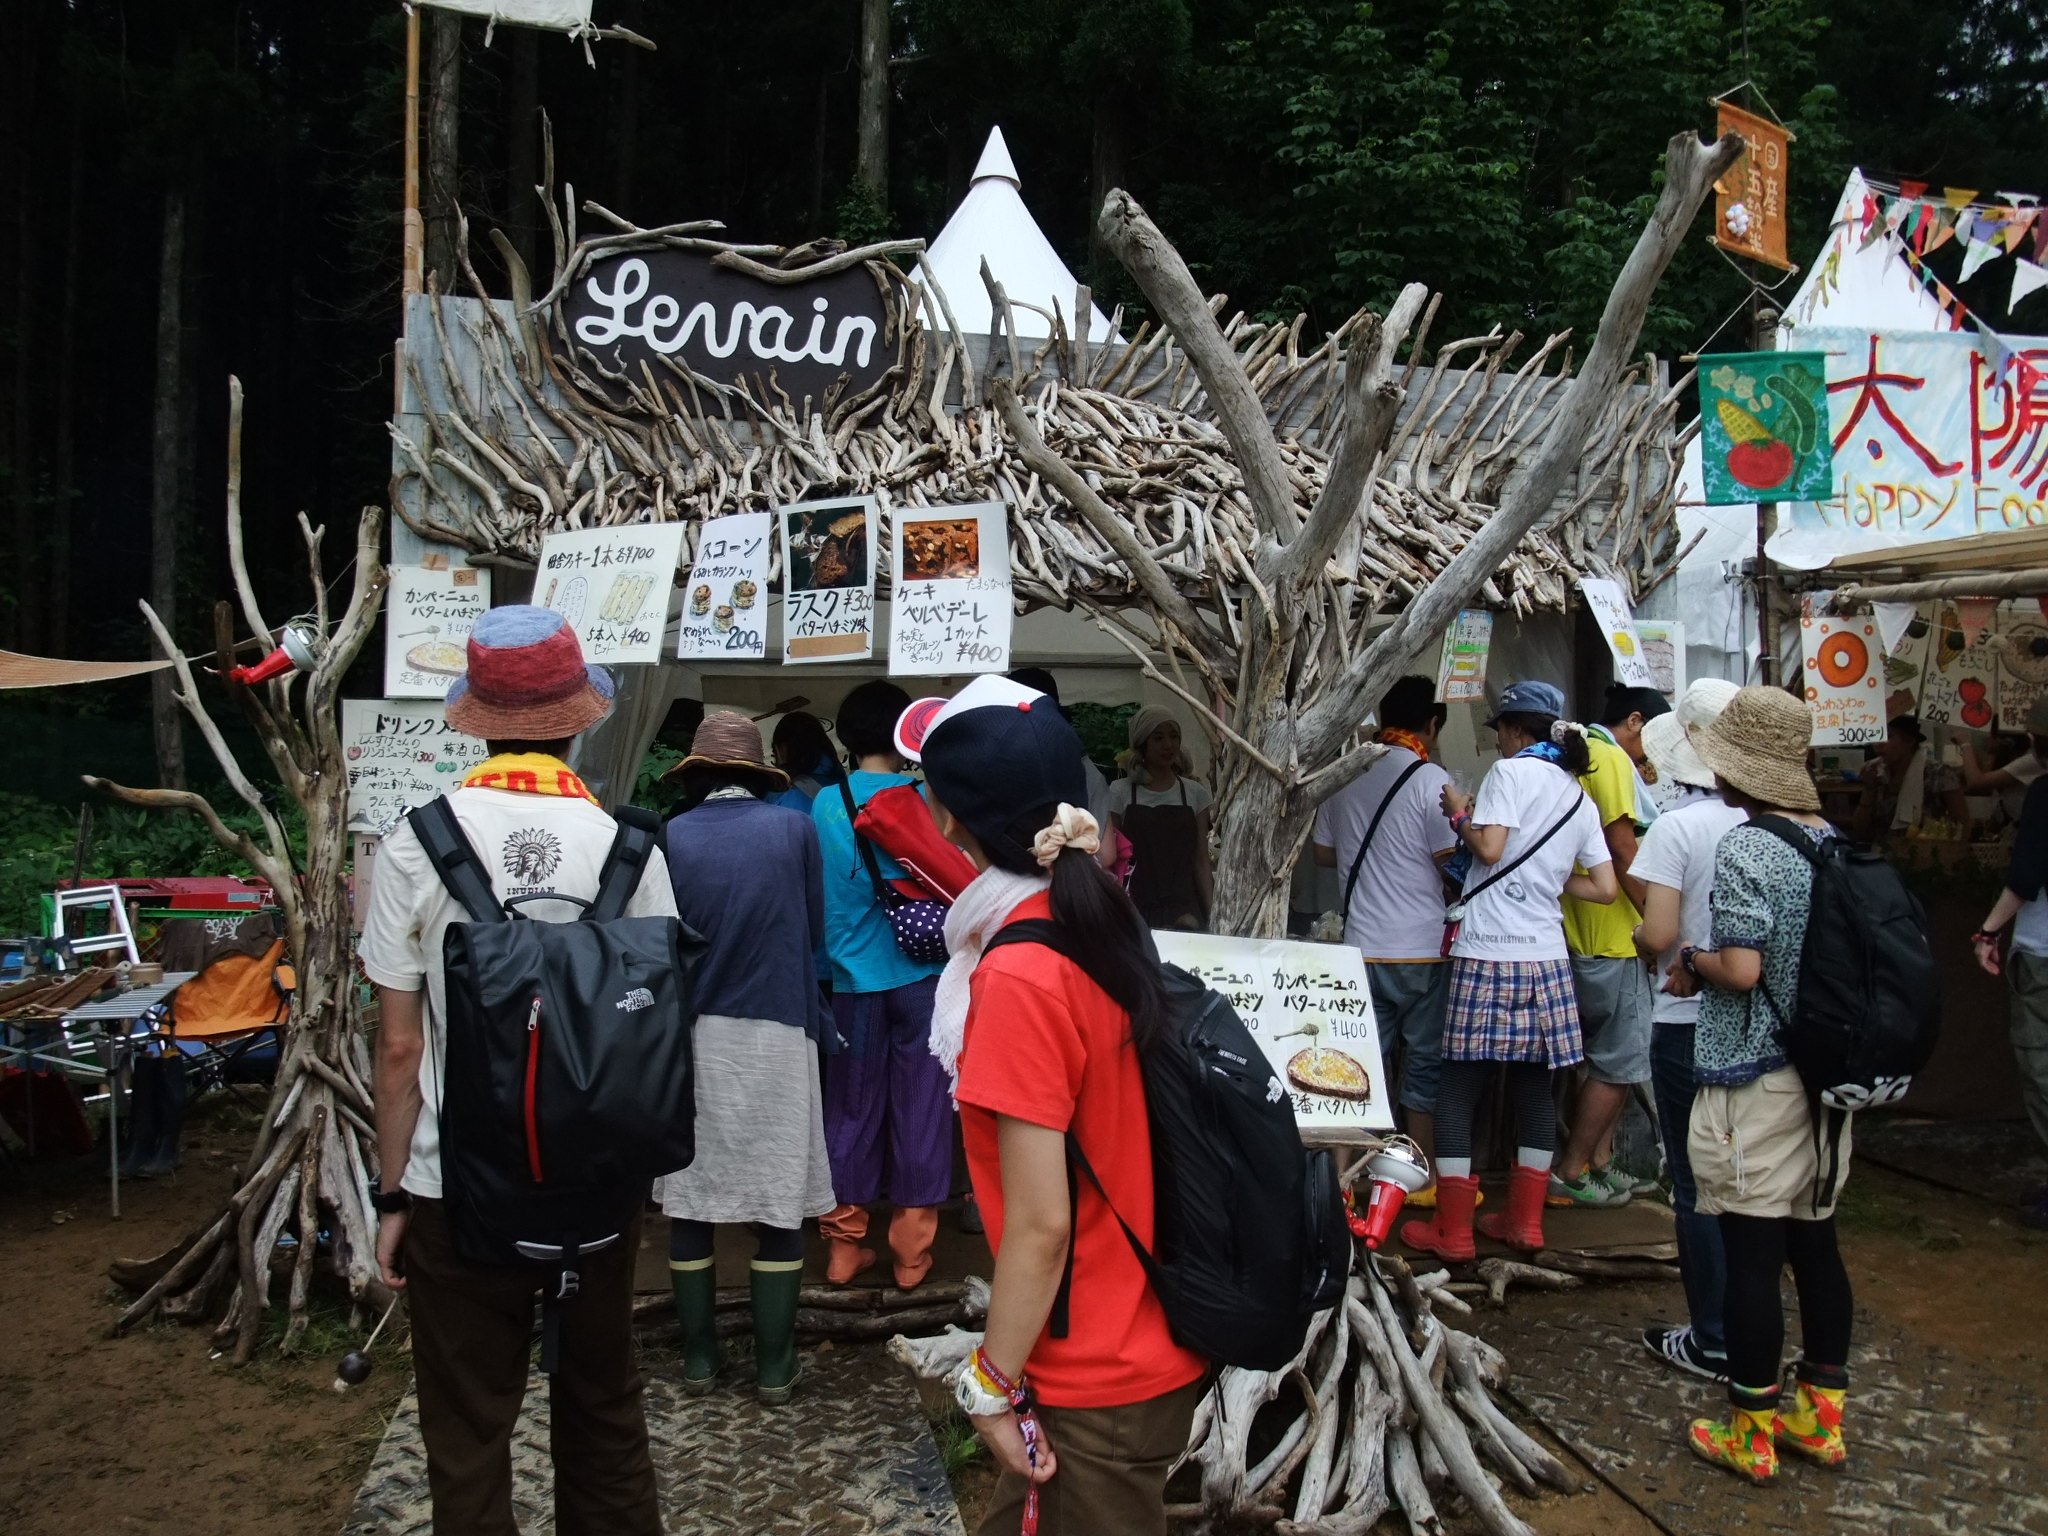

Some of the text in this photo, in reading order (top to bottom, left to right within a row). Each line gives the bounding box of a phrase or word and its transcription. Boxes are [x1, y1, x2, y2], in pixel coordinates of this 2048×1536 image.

[575, 258, 877, 368] Levain
[701, 537, 762, 563] スコーン
[405, 588, 479, 604] カンペーニュの
[898, 582, 936, 602] ケーキ
[788, 588, 873, 621] ラスク ¥300
[902, 600, 988, 624] ベルベデーレ
[447, 622, 472, 635] ¥40
[620, 627, 650, 645] ¥400
[796, 615, 870, 636] バターハチミツ味
[726, 626, 763, 654] 200円
[956, 640, 1002, 664] ¥400
[1925, 703, 1950, 724] 200
[1272, 968, 1357, 990] カンペーニュの
[625, 989, 641, 999] THE
[1283, 995, 1367, 1017] バター&ハチミツ
[1330, 1018, 1367, 1040] ¥400
